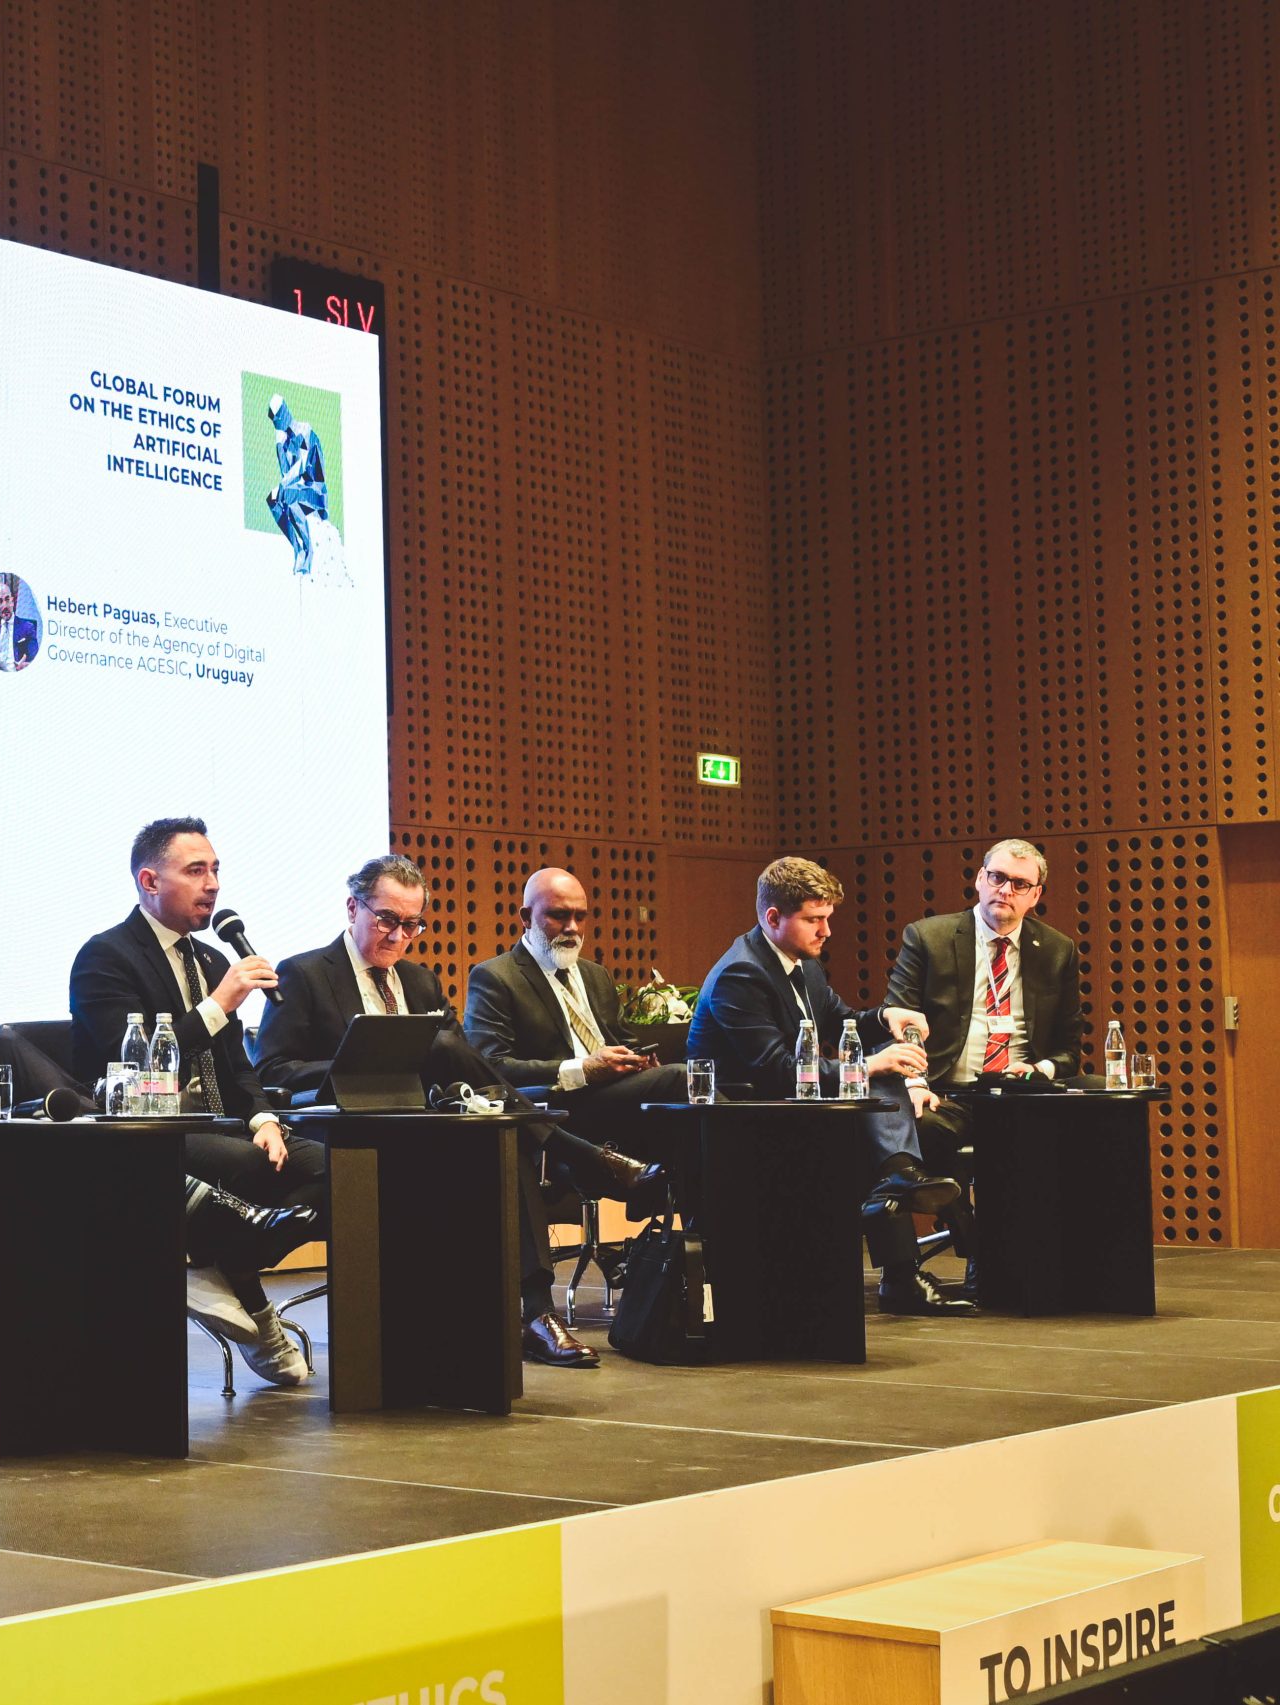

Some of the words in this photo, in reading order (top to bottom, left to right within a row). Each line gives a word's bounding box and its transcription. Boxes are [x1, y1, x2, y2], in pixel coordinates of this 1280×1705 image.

[90, 370, 159, 401] GLOBAL
[163, 386, 221, 413] FORUM
[69, 393, 95, 414] ON
[99, 399, 133, 422] THE
[138, 407, 196, 434] ETHICS
[200, 420, 222, 438] OF
[133, 433, 223, 466] ARTIFICIAL
[107, 454, 223, 492] INTELLIGENCE
[47, 595, 99, 617] Hebert
[103, 603, 160, 628] Paguas,
[163, 611, 229, 636] Executive
[47, 619, 106, 642] Director
[108, 627, 124, 645] of
[126, 630, 150, 649] the
[152, 634, 204, 659] Agency
[206, 641, 221, 657] of
[223, 642, 266, 665] Digital
[47, 643, 134, 670] Governance
[136, 655, 193, 680] AGESIC,
[195, 663, 254, 688] Uruguay
[979, 1645, 1032, 1705] TO
[1043, 1599, 1177, 1689] INSPIRE
